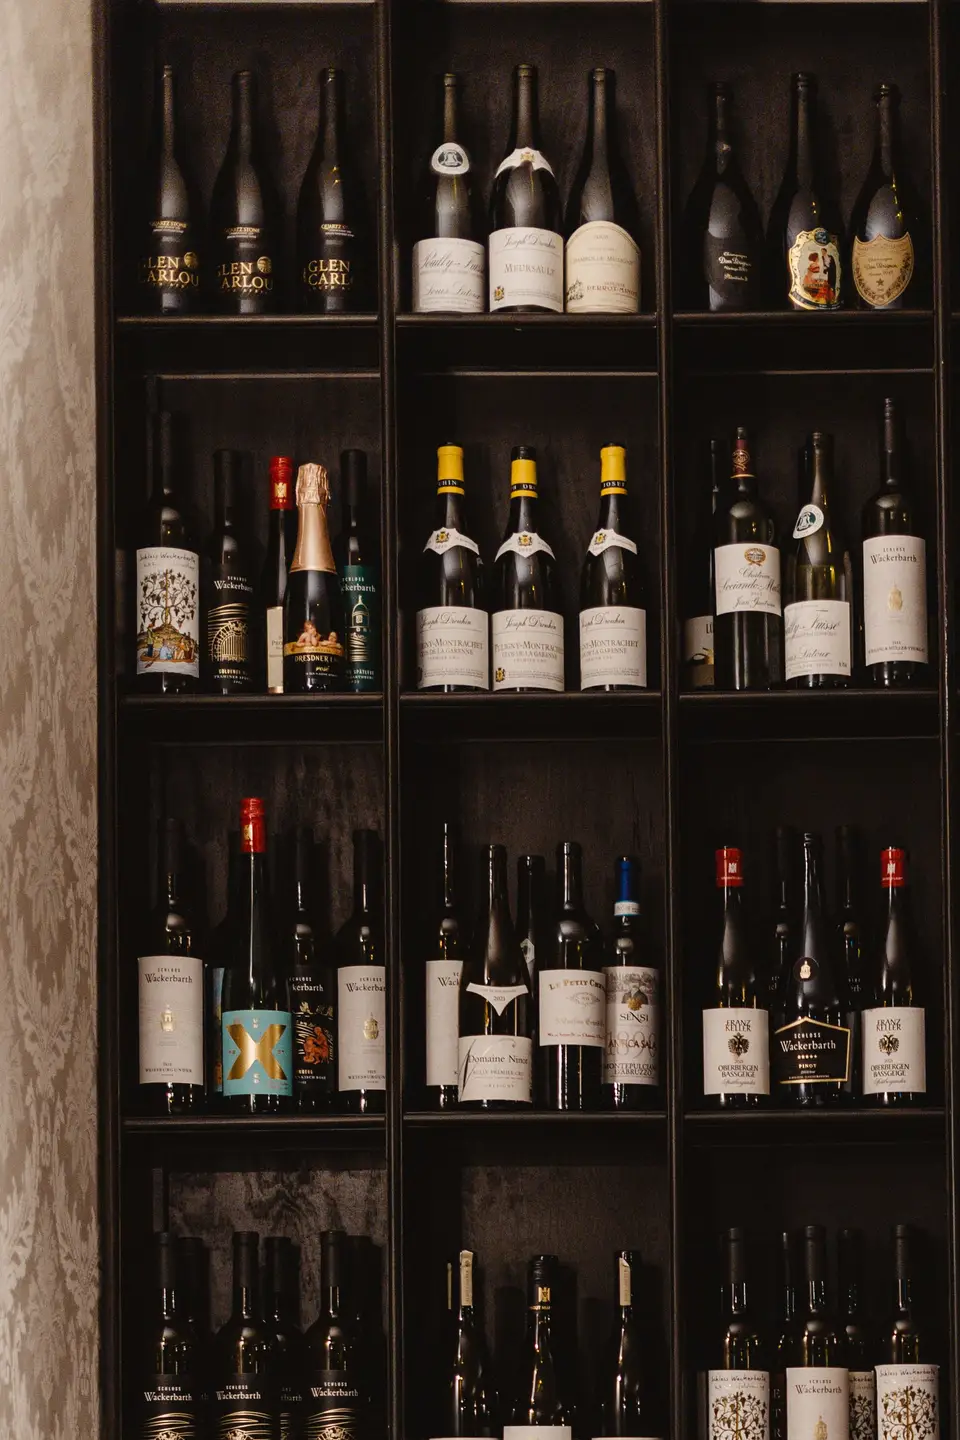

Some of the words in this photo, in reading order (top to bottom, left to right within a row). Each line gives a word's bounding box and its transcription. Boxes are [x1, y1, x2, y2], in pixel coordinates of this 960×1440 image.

[308, 259, 350, 273] GLEN
[504, 264, 556, 277] MEURSAULT
[870, 553, 918, 565] Wackerbarth
[144, 973, 193, 984] Wackerbarth
[619, 1011, 649, 1024] SENSI
[725, 1019, 752, 1027] FRANZ
[876, 1018, 901, 1026] FRANZ
[779, 1039, 837, 1053] Wackerbarth
[467, 1054, 504, 1064] Domaine
[717, 1064, 759, 1072] OBERBERGEN
[870, 1063, 910, 1071] OBERBERGEN
[215, 1390, 262, 1401] Wackerbarth
[310, 1386, 359, 1398] Wackerbarth
[795, 1385, 843, 1395] Wackerbarth
[143, 1391, 193, 1402] Wackerbarth
